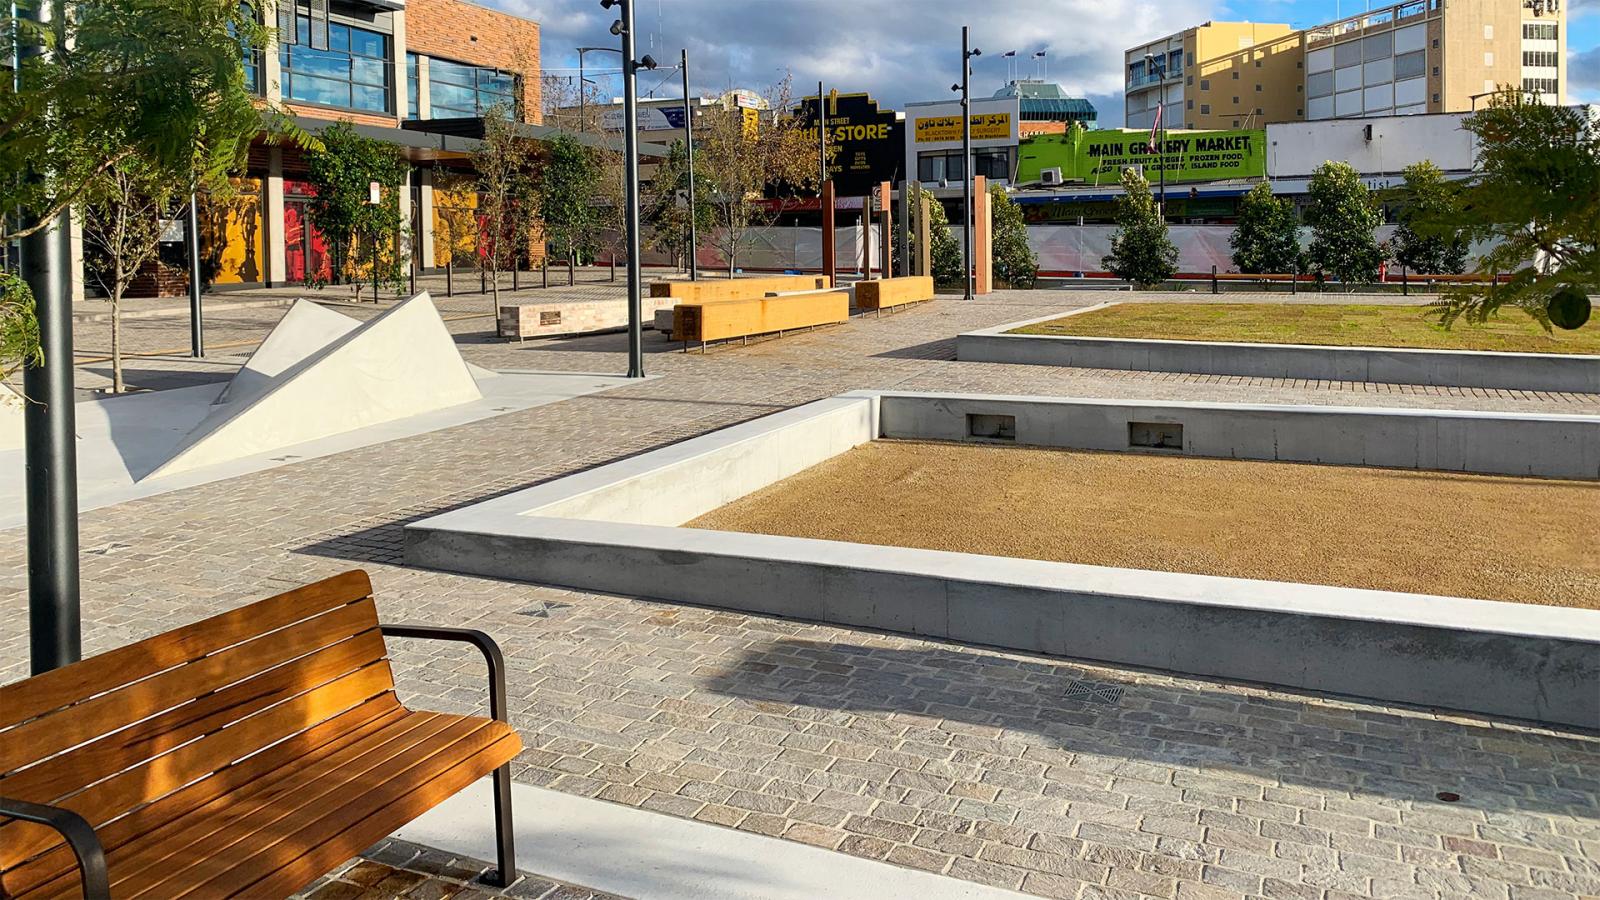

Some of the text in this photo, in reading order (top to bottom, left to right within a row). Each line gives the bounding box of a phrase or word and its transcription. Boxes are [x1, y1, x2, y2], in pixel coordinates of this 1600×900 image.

[830, 117, 849, 125] STREET
[835, 123, 888, 141] STORE
[1089, 136, 1250, 157] MAIN GRCERY MARKET
[1129, 157, 1151, 165] FRUIT
[1191, 162, 1218, 170] ISLAND
[1220, 161, 1240, 169] FOOD
